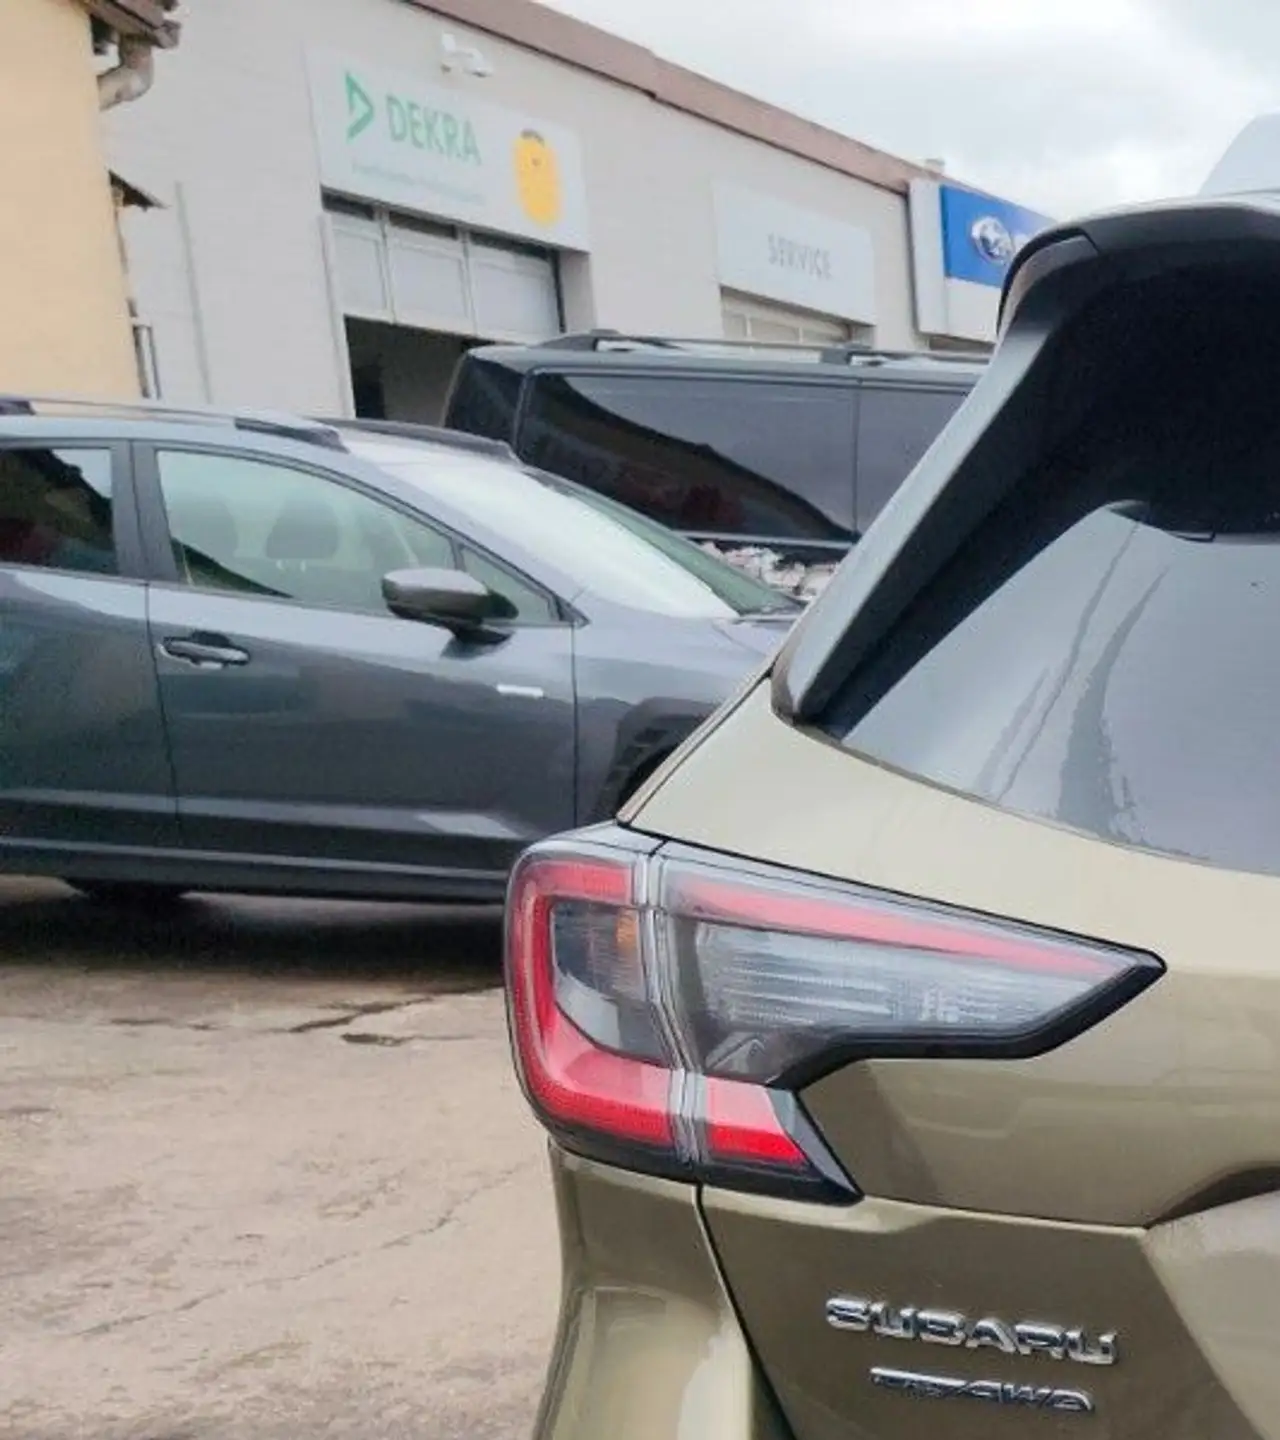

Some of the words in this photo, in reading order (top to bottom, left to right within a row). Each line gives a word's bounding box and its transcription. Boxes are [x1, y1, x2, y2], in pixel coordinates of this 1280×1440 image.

[385, 94, 482, 166] DEKRA
[767, 232, 832, 280] SERVICE
[825, 1296, 1119, 1365] SUBARU
